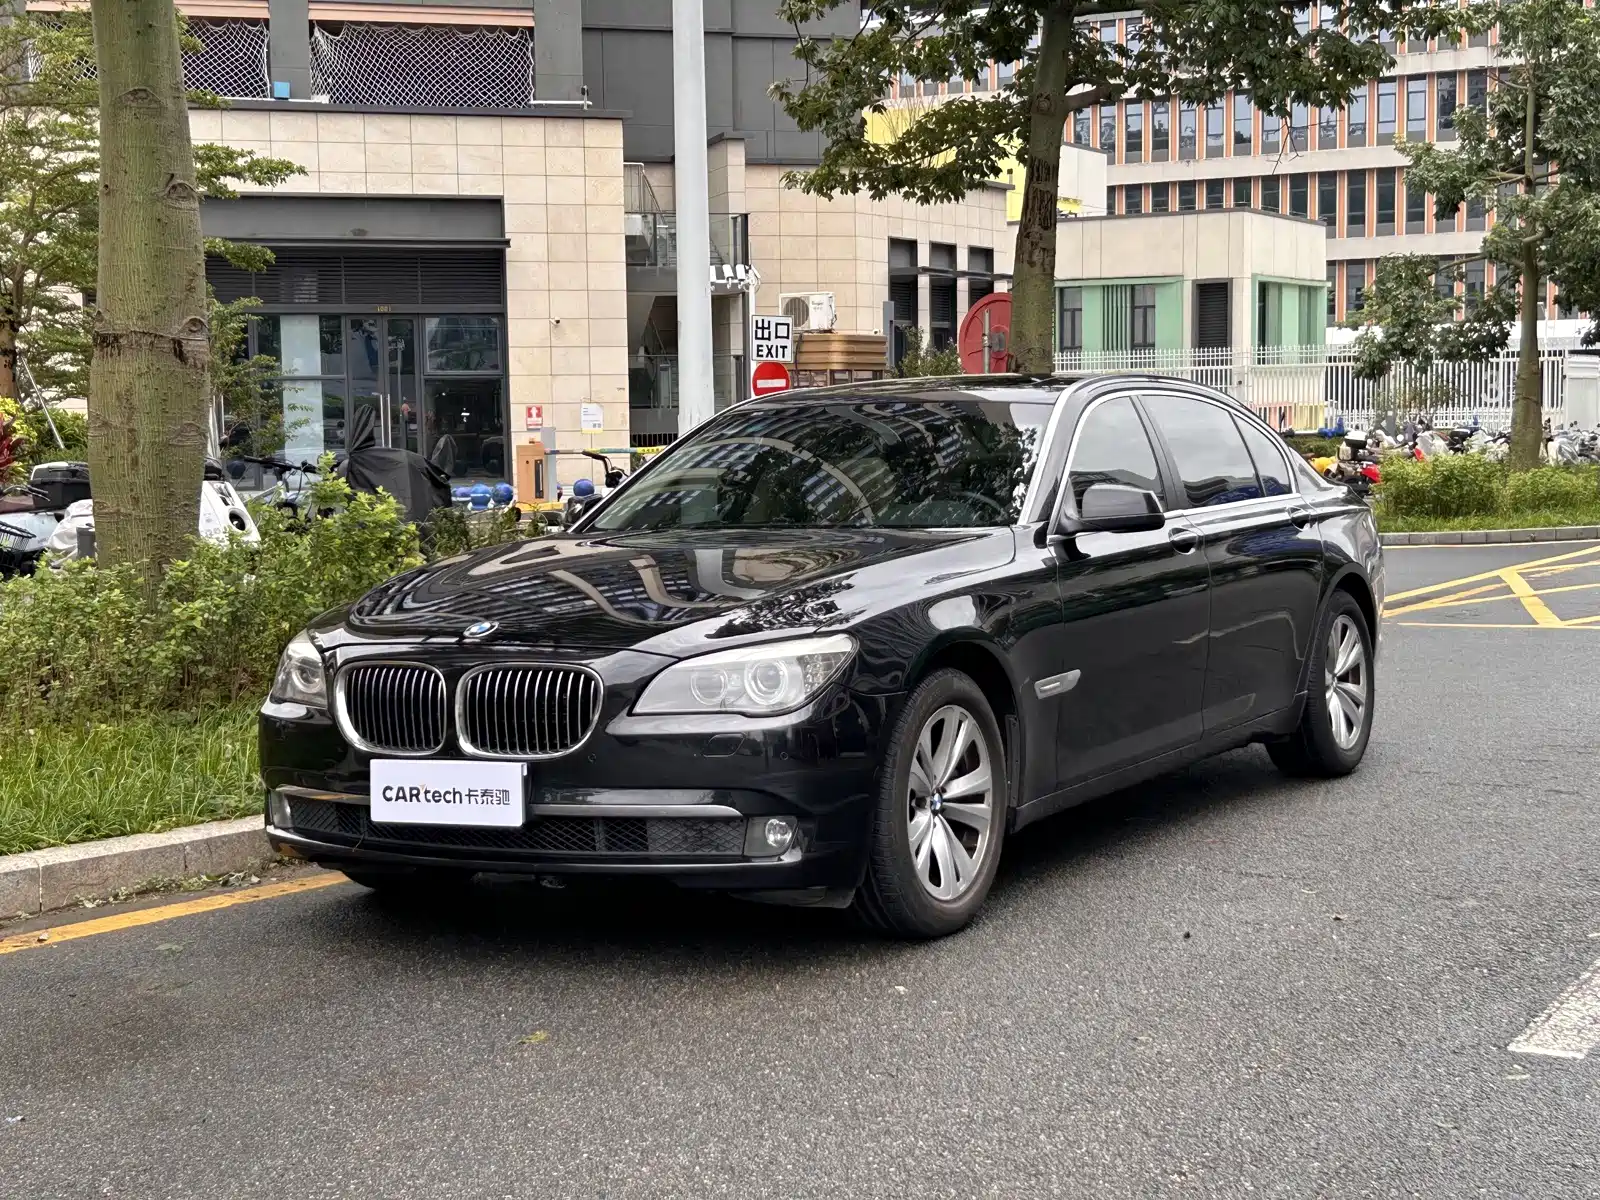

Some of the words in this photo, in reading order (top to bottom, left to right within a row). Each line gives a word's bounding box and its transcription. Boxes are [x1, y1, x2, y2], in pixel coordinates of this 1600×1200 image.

[755, 318, 790, 341] 出口
[756, 344, 788, 358] EXIT
[465, 787, 511, 805] 卡泰驰
